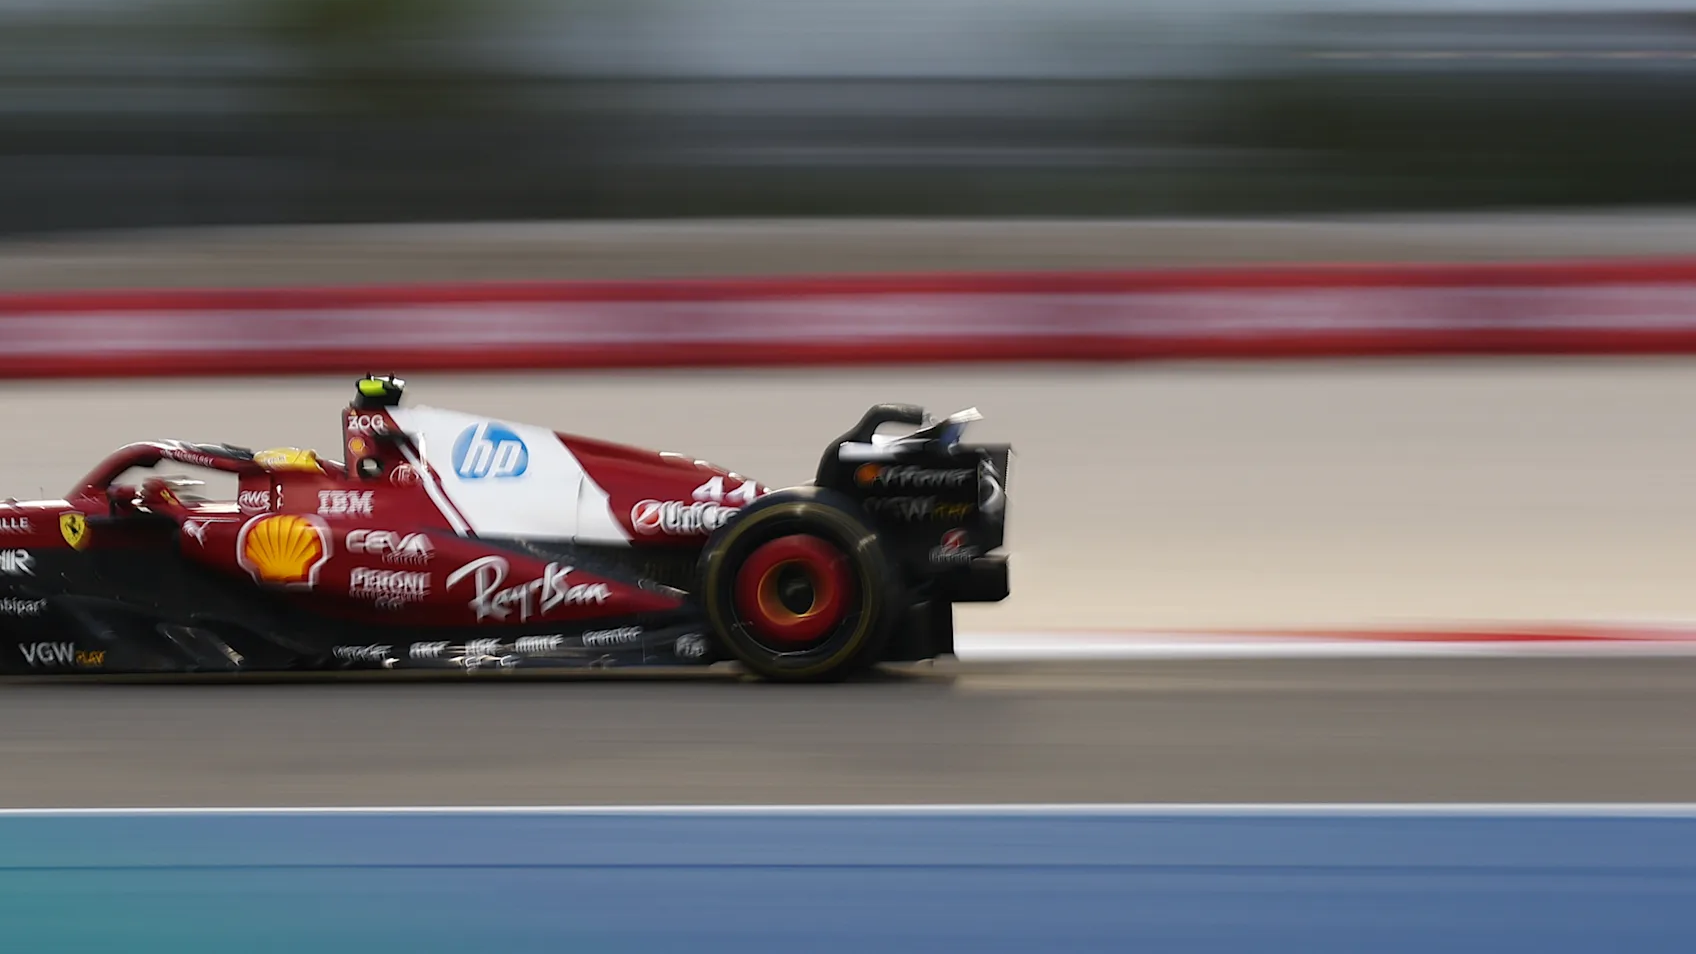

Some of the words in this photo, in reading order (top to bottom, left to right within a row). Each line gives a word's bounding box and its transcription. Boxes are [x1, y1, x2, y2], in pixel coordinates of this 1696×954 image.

[348, 414, 384, 431] ZCG
[458, 422, 524, 477] hp
[239, 490, 271, 505] aws
[692, 475, 757, 505] 44
[317, 490, 375, 517] IBM
[346, 529, 435, 555] CEVA
[19, 642, 75, 664] VGW
[76, 650, 106, 666] PLAY
